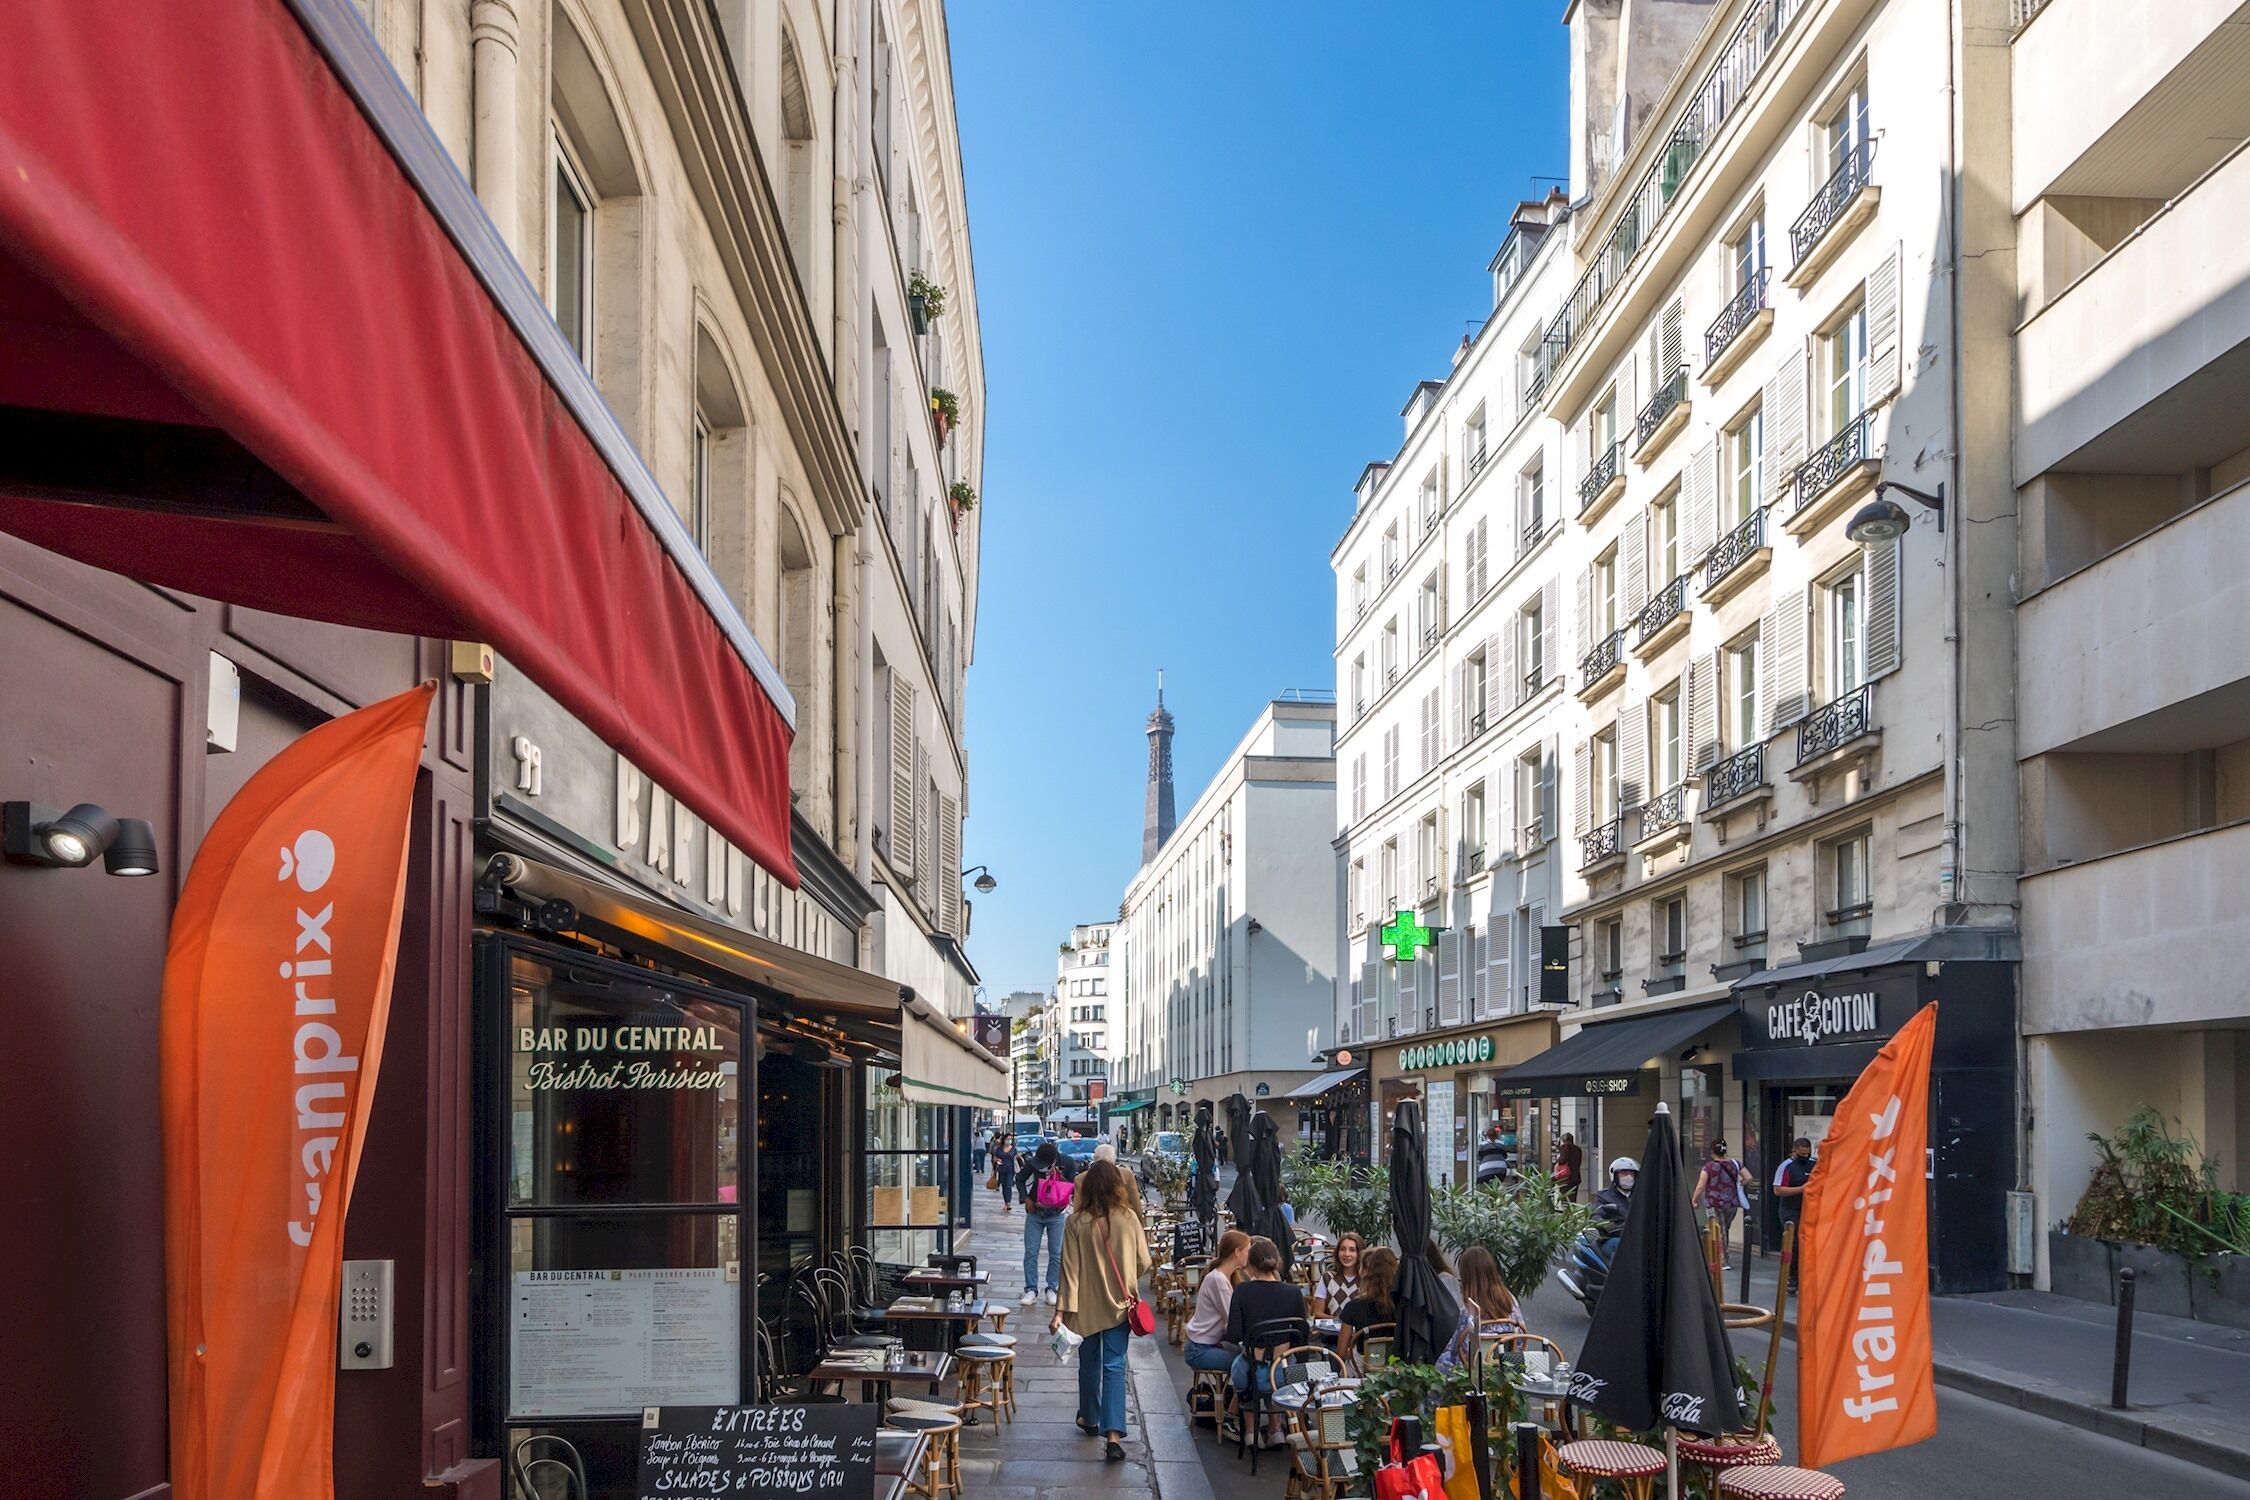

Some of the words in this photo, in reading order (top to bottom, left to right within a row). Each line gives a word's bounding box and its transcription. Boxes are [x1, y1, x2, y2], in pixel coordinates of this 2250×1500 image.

[512, 735, 542, 797] 99
[1768, 998, 1802, 1040] CAFÉ
[1822, 992, 1877, 1035] COTON
[520, 1027, 568, 1051] BAR
[576, 1027, 608, 1051] DU
[614, 1026, 724, 1051] CENTRAL
[1400, 1038, 1489, 1068] PHARMACIE
[524, 1059, 625, 1091] Bistrot
[623, 1060, 727, 1090] Parisien
[530, 1271, 548, 1281] BAR
[551, 1271, 562, 1280] DU
[564, 1271, 606, 1281] CENTRAL
[648, 1433, 683, 1452] Jambon
[655, 1469, 731, 1494] SALADES
[819, 1469, 845, 1489] CRU
